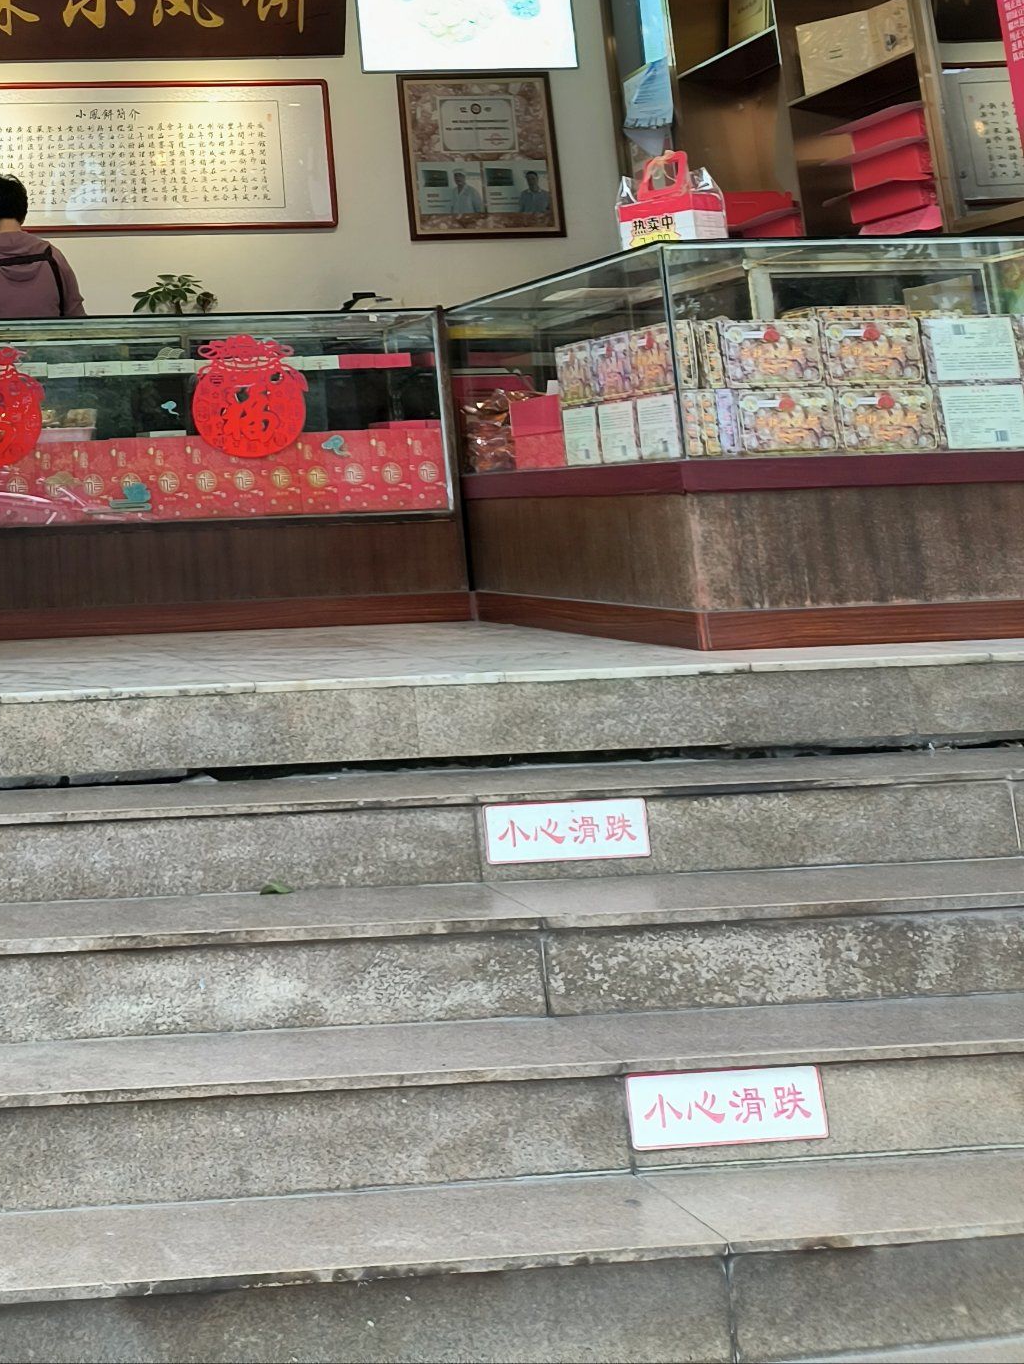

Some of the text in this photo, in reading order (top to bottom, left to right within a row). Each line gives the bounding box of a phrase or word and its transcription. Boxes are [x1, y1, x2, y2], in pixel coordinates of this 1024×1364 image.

[633, 215, 674, 234] 热卖中
[497, 812, 638, 848] 小心滑跌
[643, 1083, 812, 1128] 小心滑跌
